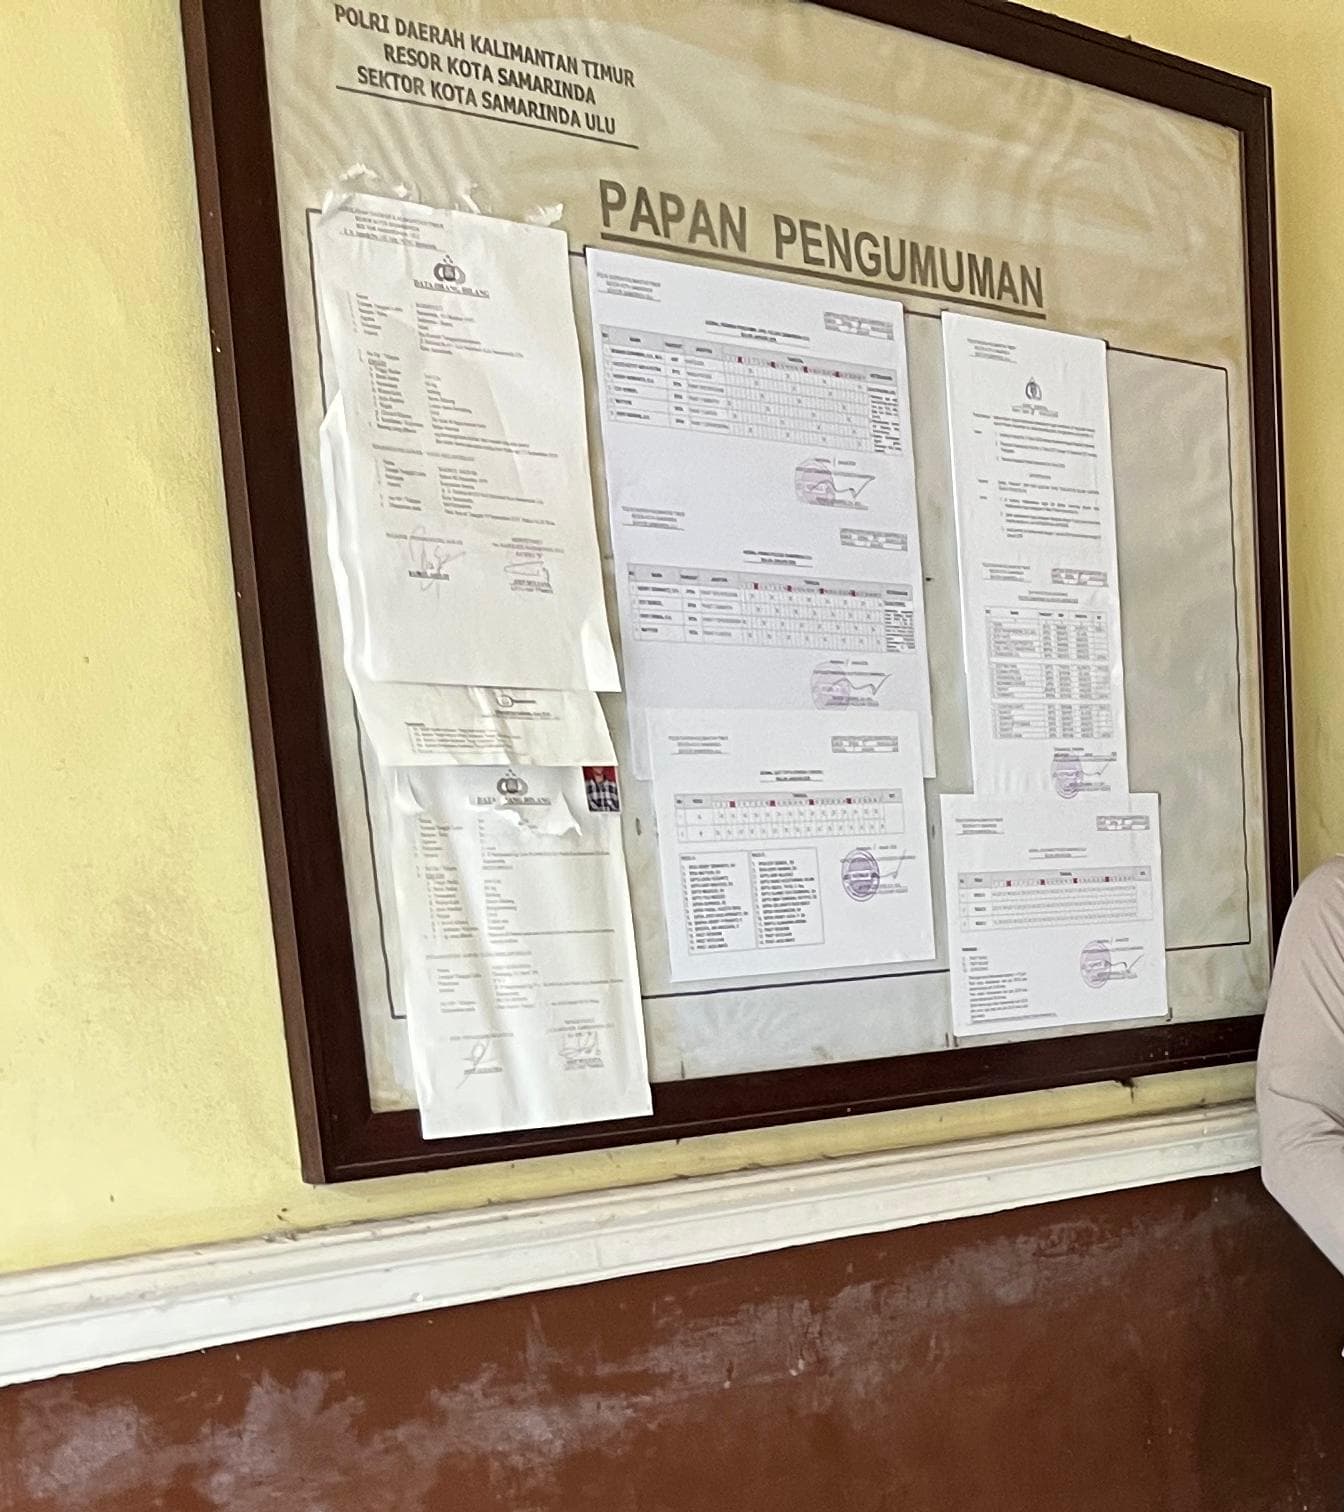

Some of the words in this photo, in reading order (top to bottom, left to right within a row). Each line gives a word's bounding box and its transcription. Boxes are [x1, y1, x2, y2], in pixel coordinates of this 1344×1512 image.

[335, 4, 390, 34] POLRI
[395, 18, 465, 50] DAERAH
[470, 35, 578, 75] KALIMANTAN
[581, 58, 636, 88] TIMUR
[384, 43, 443, 73] RESOR
[446, 55, 494, 84] KOTA
[498, 67, 597, 105] SAMARINDA
[357, 65, 425, 96] SEKTOR
[430, 79, 478, 108] KOTA
[481, 91, 582, 129] SAMARINDA
[584, 112, 616, 135] ULU
[599, 178, 747, 253] PAPAN
[774, 213, 1044, 308] PENGUMUMAN
